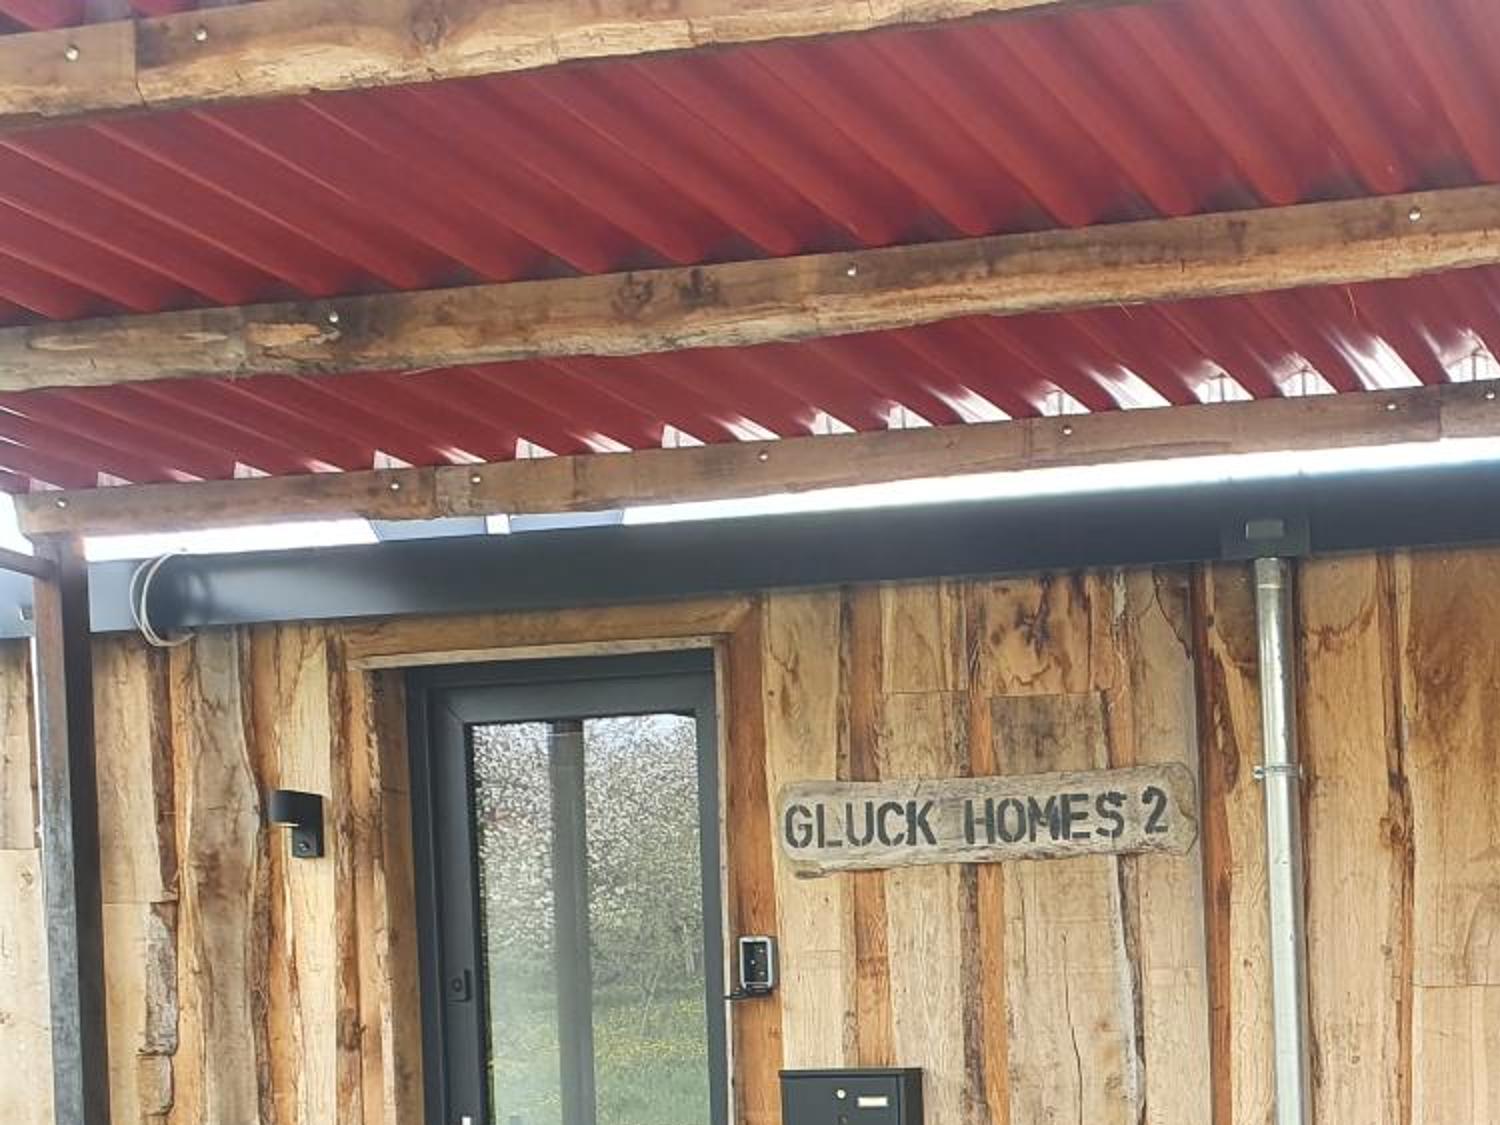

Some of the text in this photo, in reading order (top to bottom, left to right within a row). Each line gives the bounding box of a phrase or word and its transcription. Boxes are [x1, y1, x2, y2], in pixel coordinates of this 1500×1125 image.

[784, 785, 1169, 849] GLUCK HOMES 2
